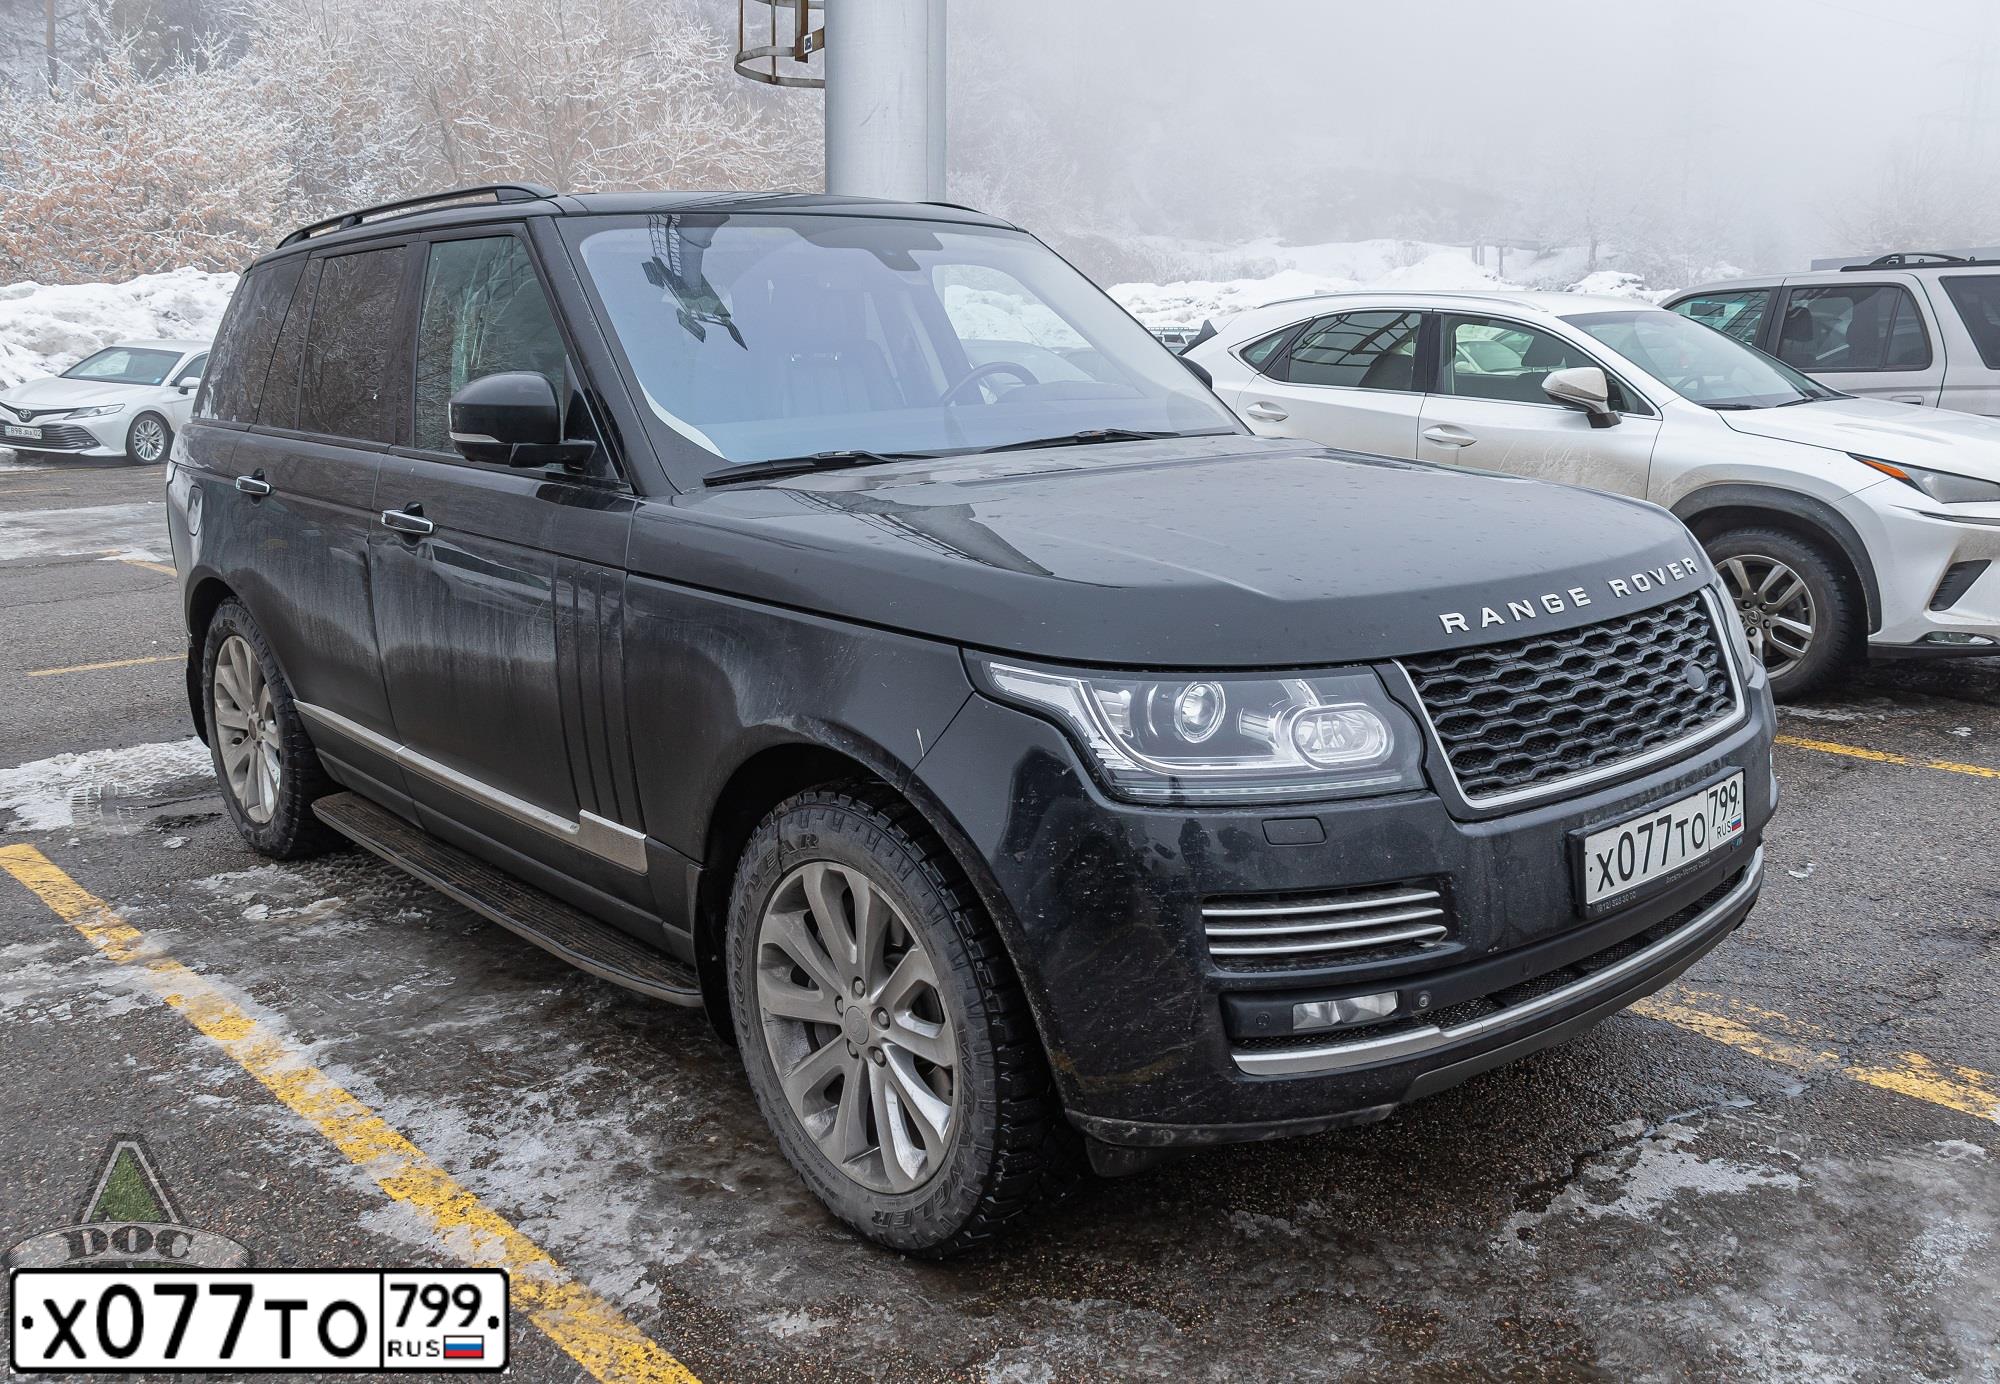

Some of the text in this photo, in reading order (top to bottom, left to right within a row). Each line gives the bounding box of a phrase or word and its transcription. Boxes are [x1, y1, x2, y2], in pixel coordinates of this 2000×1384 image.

[1438, 557, 1698, 634] RANGE ROVER
[1596, 813, 1706, 893] X077TO
[1709, 780, 1738, 828] 799
[1716, 820, 1732, 839] RUS
